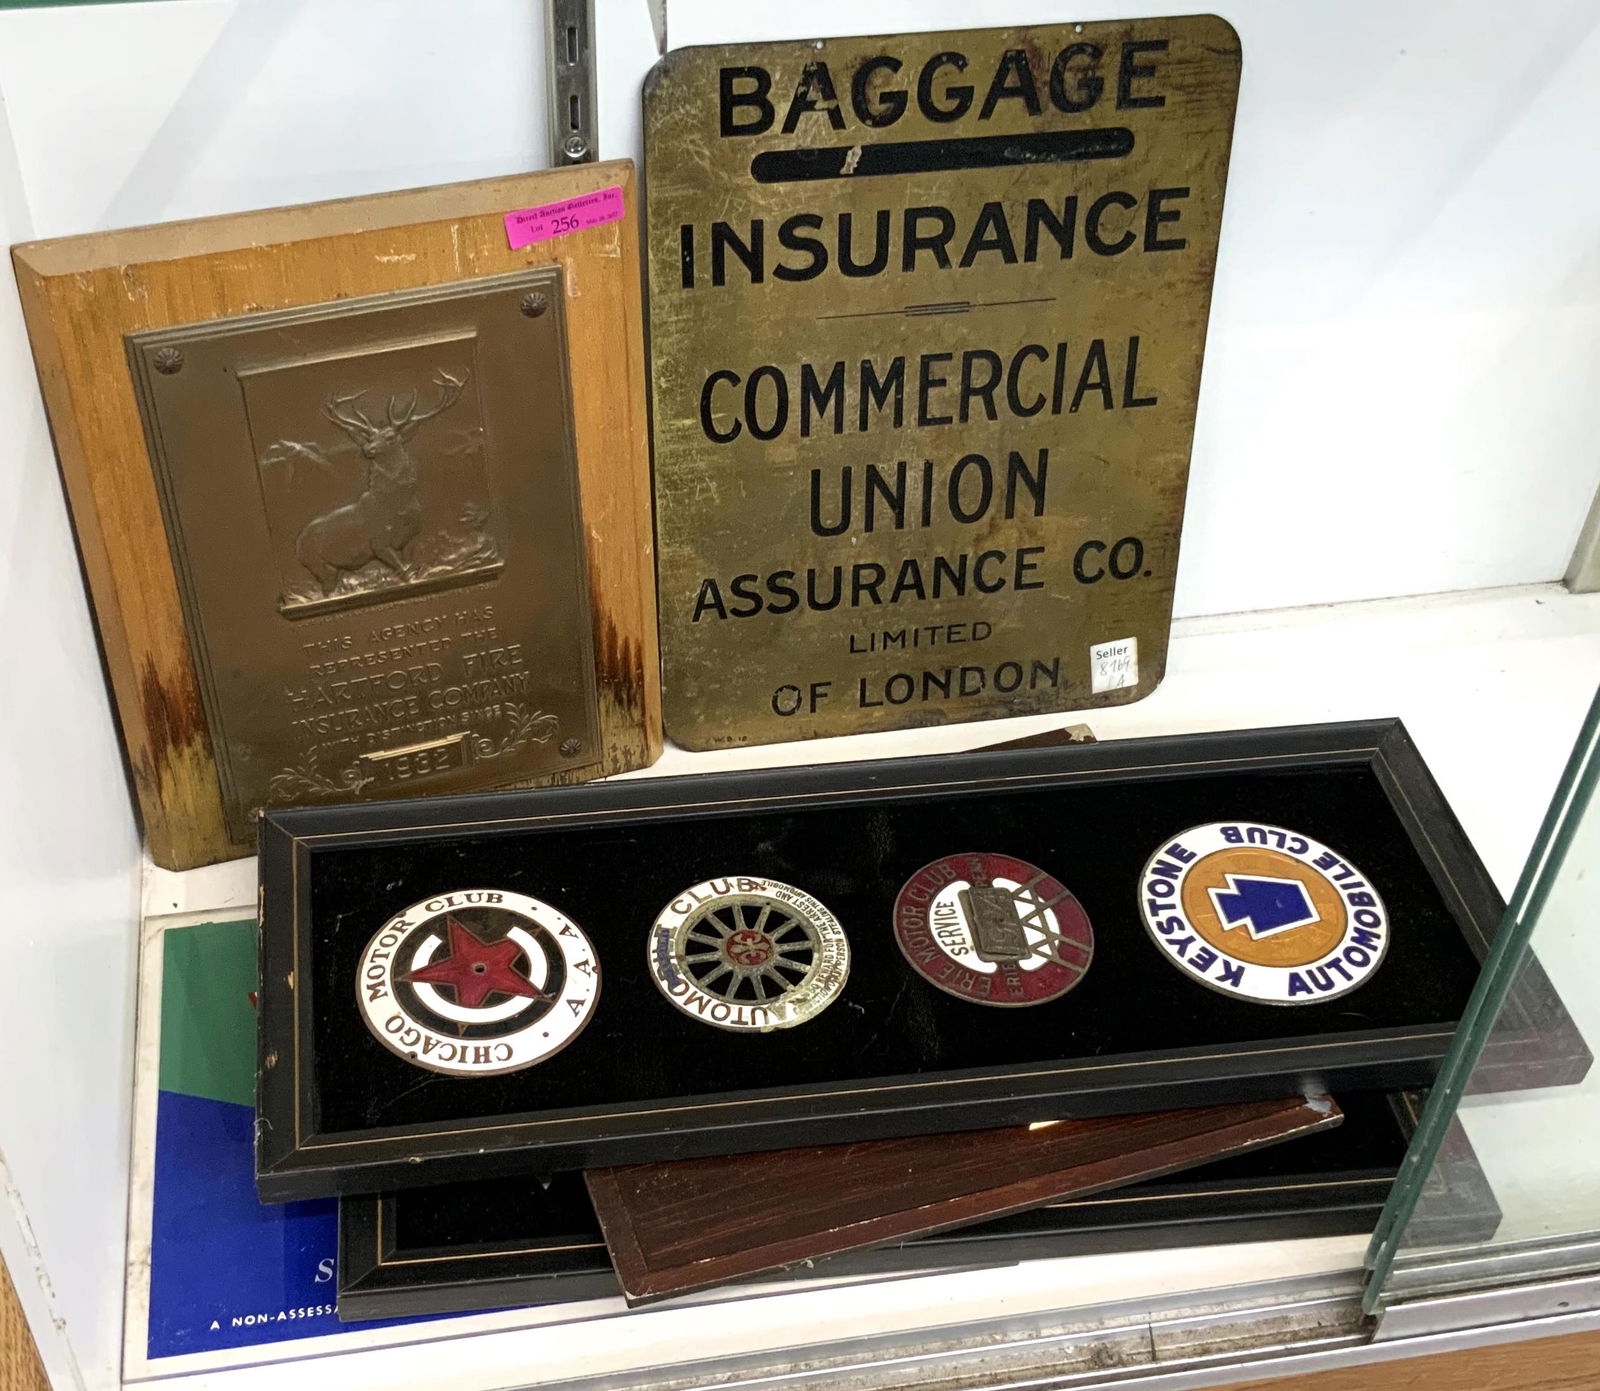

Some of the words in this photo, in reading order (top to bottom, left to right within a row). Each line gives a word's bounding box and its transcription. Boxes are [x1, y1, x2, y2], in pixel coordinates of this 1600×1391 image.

[719, 40, 1168, 138] BAGGAGE
[531, 225, 544, 233] Lot
[551, 214, 579, 234] 256
[680, 187, 1190, 289] INSURANCE
[700, 336, 1157, 444] COMMERCIAL
[810, 449, 1048, 537] UNION
[691, 547, 1045, 622] ASSURANCE
[1072, 537, 1152, 584] CO.
[302, 635, 353, 655] THIS
[369, 614, 447, 644] AGENCY
[455, 605, 495, 625] HAS
[849, 621, 992, 653] LIMITED
[309, 637, 452, 676] REPRESENTED
[459, 627, 498, 647] THE
[1096, 646, 1128, 660] Seller
[286, 662, 446, 712] HARTFORD
[463, 644, 524, 676] FIRE
[771, 681, 830, 717] OF
[859, 657, 1060, 707] LONDON
[291, 695, 419, 742] INSURANCE
[427, 670, 531, 710] COMPANY
[1220, 826, 1309, 855] CLUB
[671, 878, 752, 915] CLUB
[761, 879, 808, 899] AUTOMOBILE
[775, 890, 795, 902] AND
[909, 863, 957, 902] CLUB
[424, 892, 504, 913] CLUB
[794, 898, 821, 922] ARREST
[805, 897, 820, 909] THIS
[817, 907, 841, 935] STEALING
[1147, 842, 1246, 988] KEYSTONE
[817, 922, 831, 938] THE
[903, 905, 939, 965] MOTOR
[934, 901, 970, 956] SERVICE
[1288, 851, 1382, 997] AUTOMOBILE
[366, 920, 416, 1003] MOTOR
[822, 938, 835, 953] FOR
[936, 964, 992, 997] ERIE
[1005, 964, 1024, 997] ERIE
[385, 1015, 514, 1065] CHICAGO
[209, 1319, 220, 1330] A
